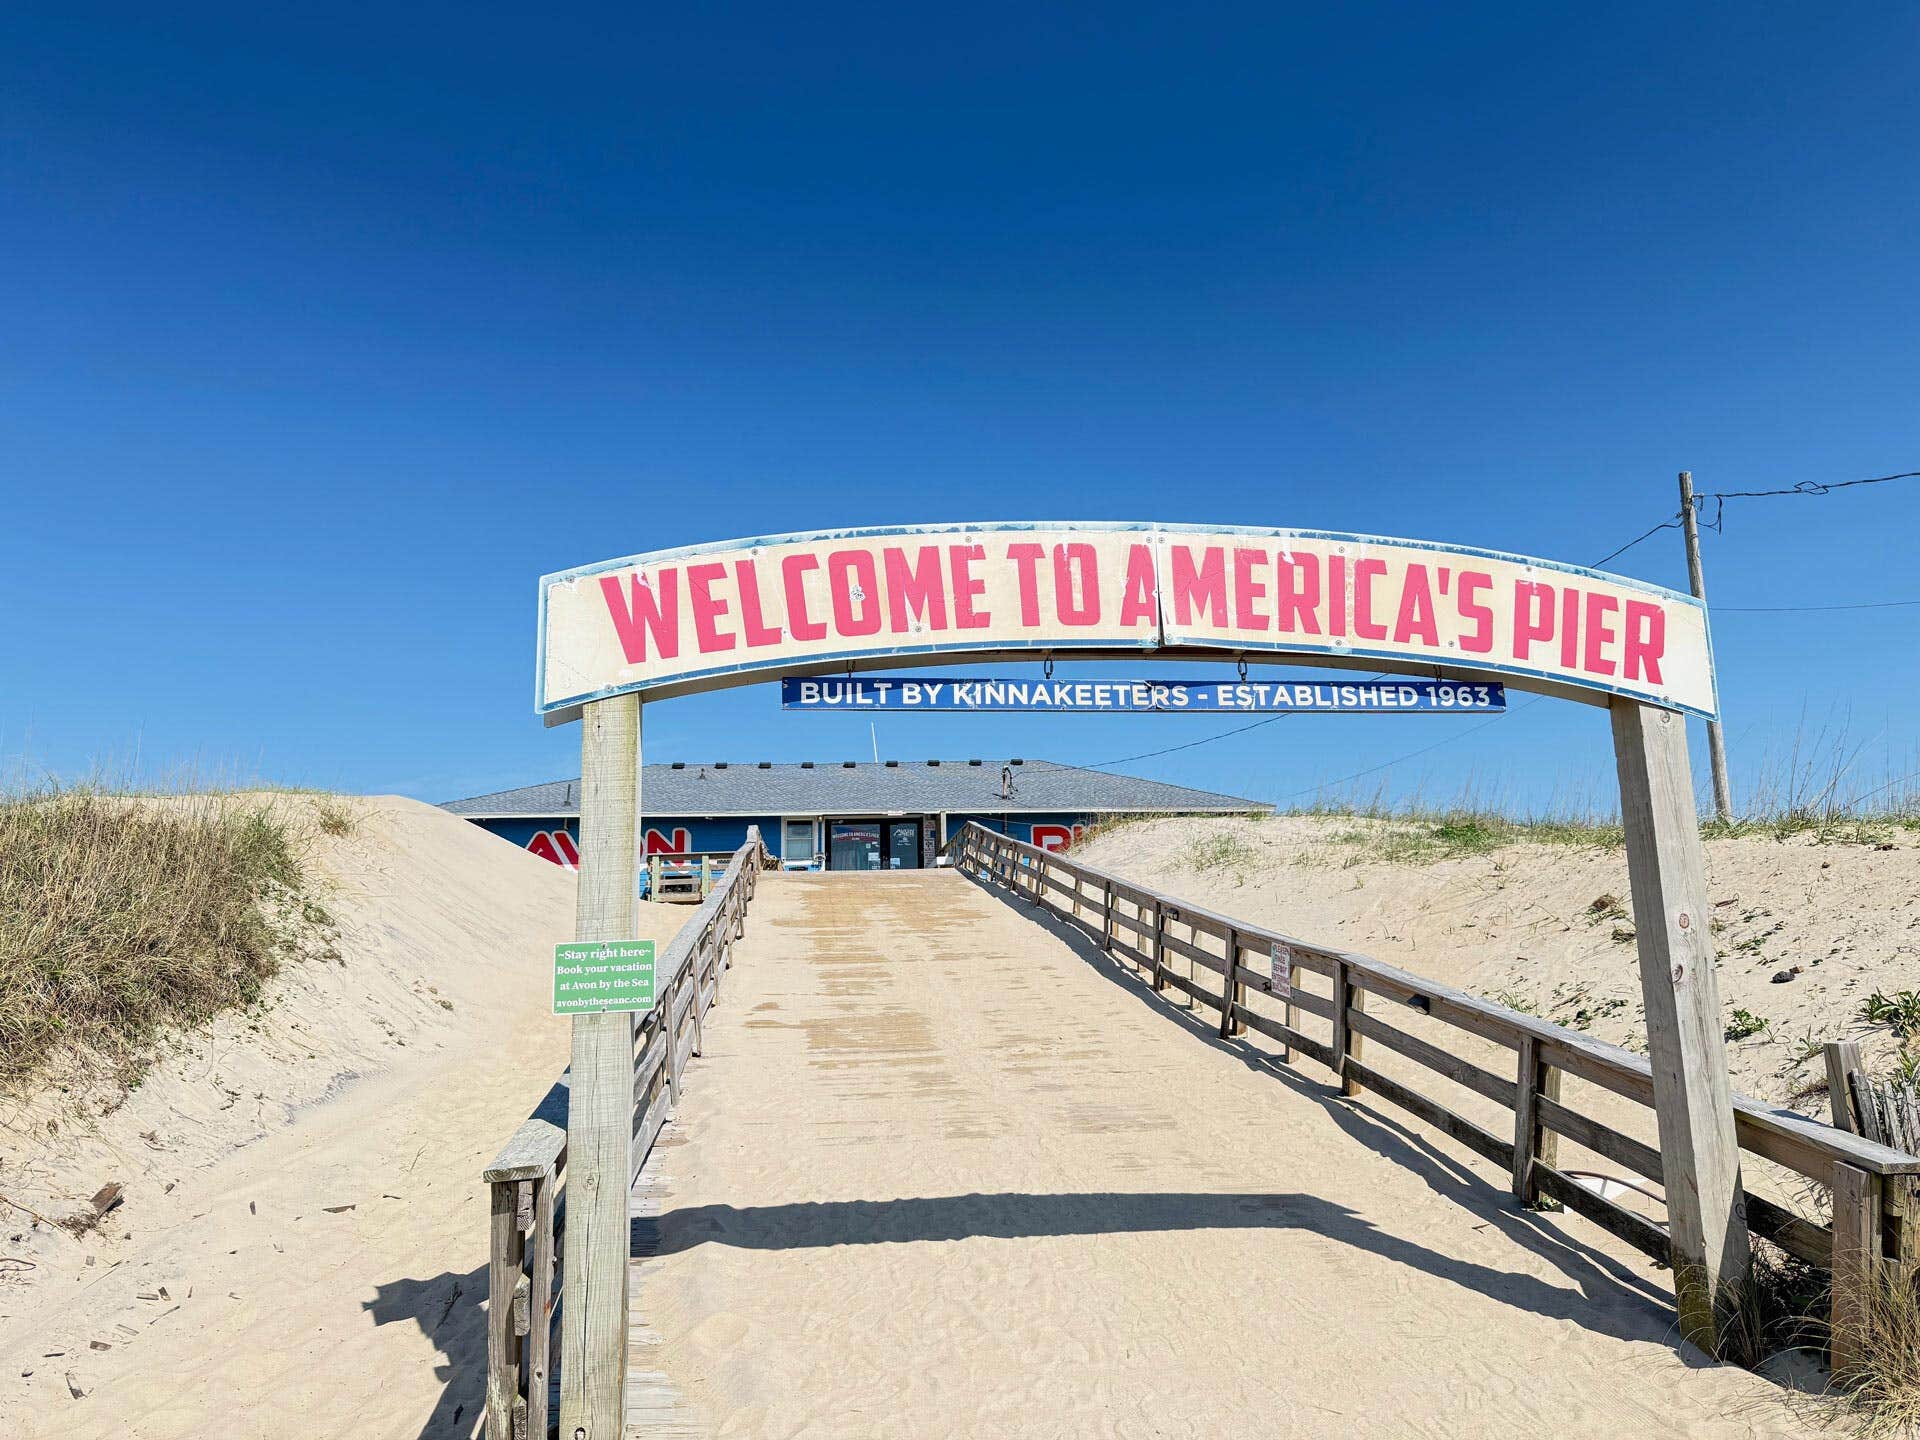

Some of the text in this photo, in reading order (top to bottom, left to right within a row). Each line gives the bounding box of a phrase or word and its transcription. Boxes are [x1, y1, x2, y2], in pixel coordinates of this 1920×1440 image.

[600, 543, 1666, 685] WELCOME TO AMERICA'S PIER
[801, 682, 892, 705] BUILT
[902, 683, 943, 705] BY
[953, 683, 1189, 707] KINNAKEETERS
[1217, 684, 1419, 708] ESTABLISHED
[1426, 685, 1490, 707] 1963
[524, 827, 692, 872] AVN
[590, 948, 617, 960] right
[557, 962, 652, 976] Book your vacation
[560, 978, 649, 991] at Avon by the Sea
[556, 996, 651, 1008] avonbytheseanc.com
